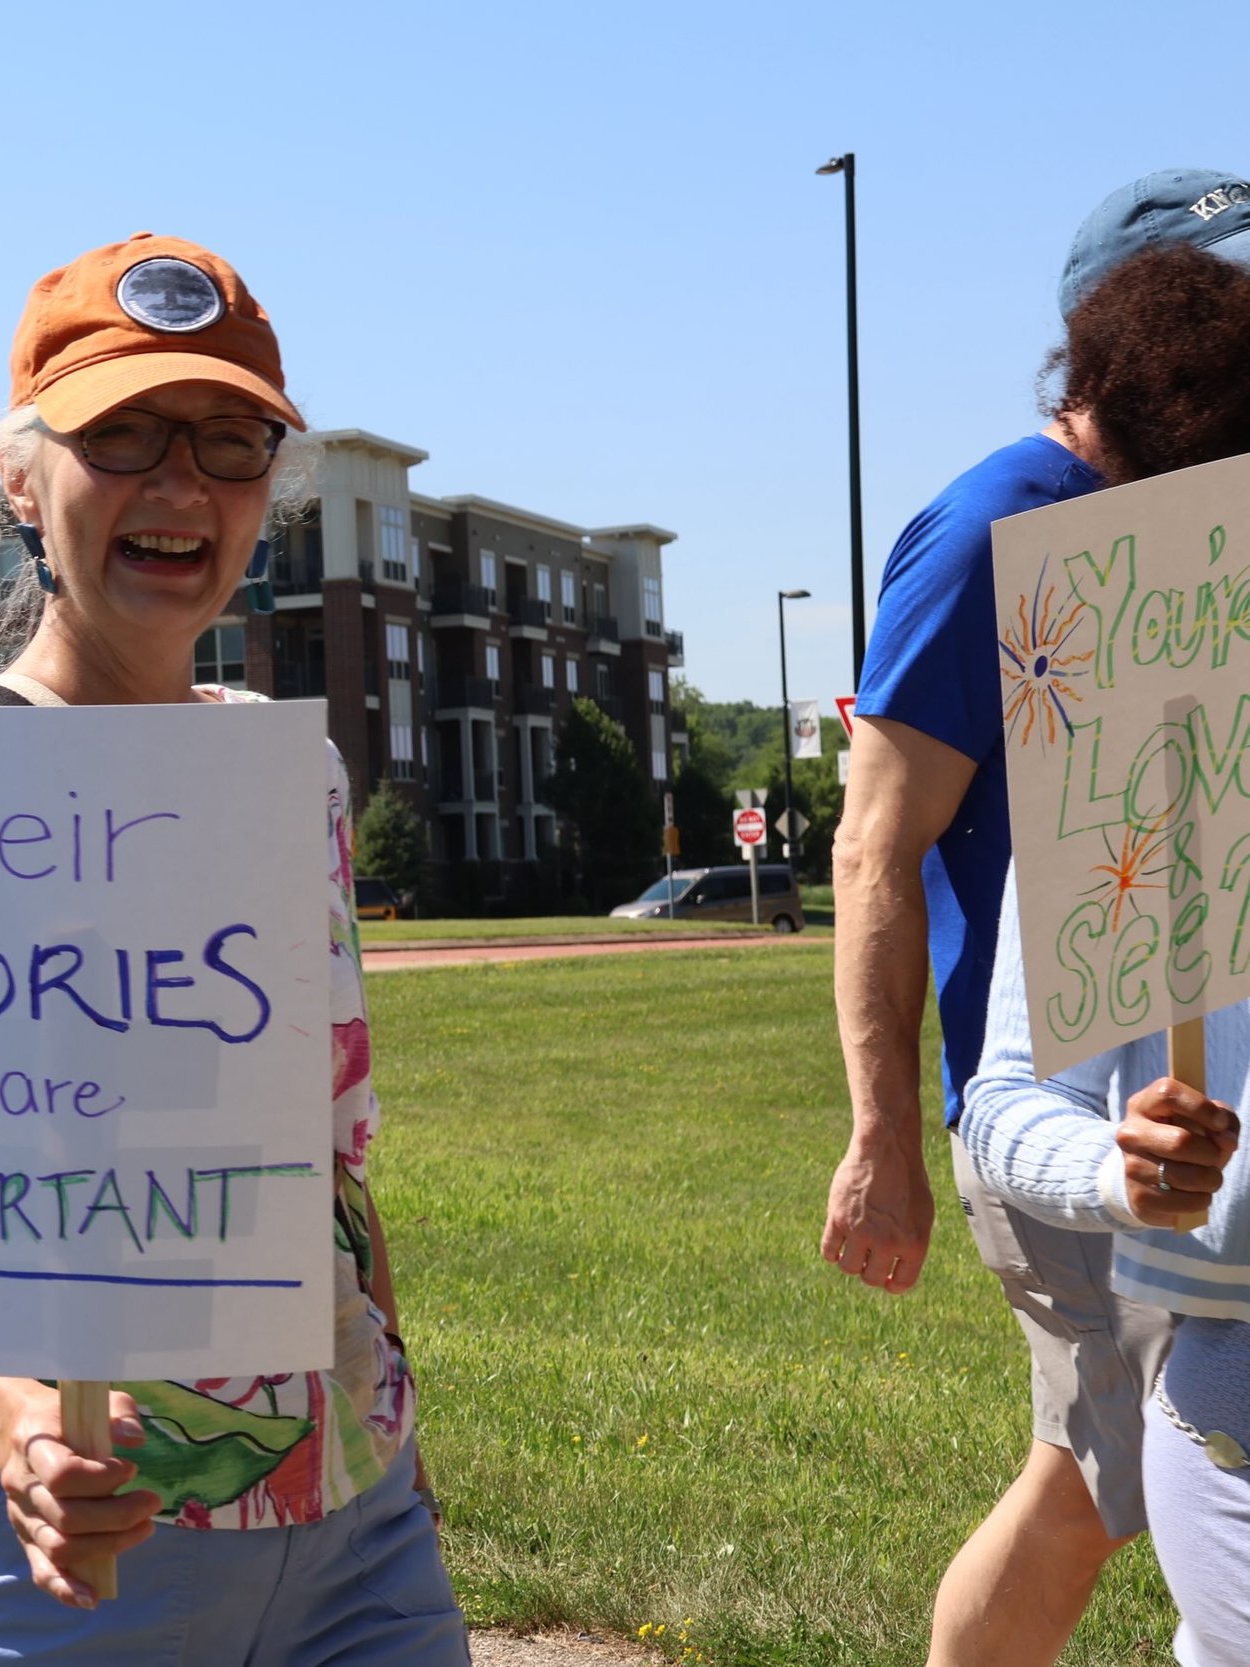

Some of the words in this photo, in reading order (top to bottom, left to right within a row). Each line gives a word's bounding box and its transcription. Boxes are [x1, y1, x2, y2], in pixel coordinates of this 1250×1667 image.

[1168, 820, 1204, 900] &
[1047, 829, 1250, 1042] See
[0, 1071, 125, 1118] are
